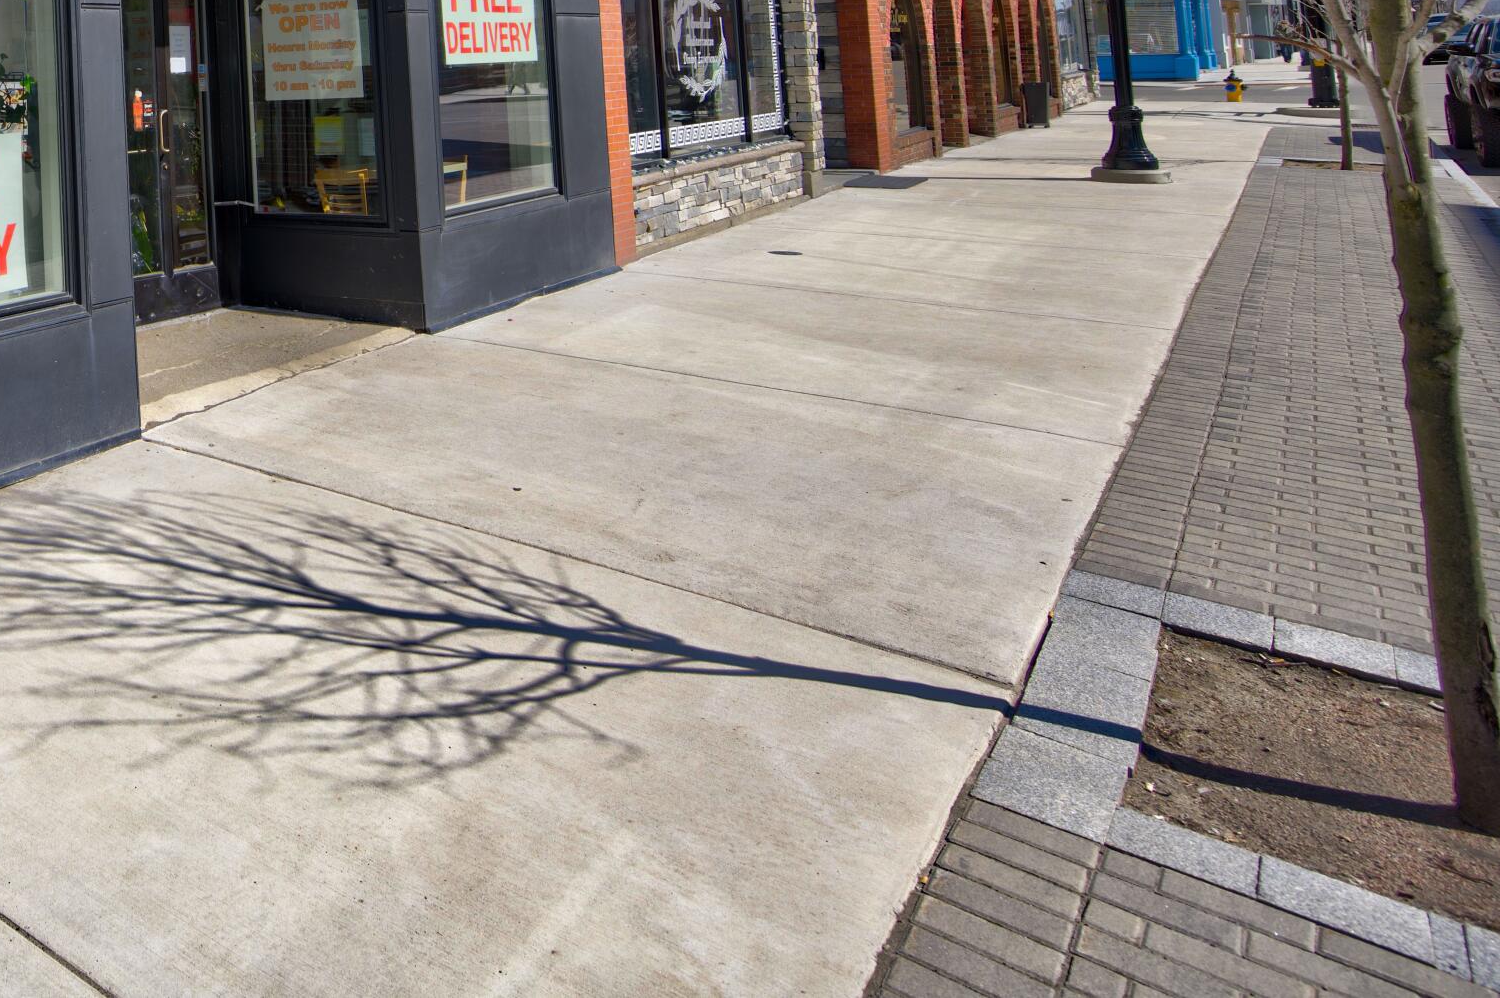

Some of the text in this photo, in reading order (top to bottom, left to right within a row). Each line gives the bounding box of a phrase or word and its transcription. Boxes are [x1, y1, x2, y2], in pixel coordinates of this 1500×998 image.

[268, 0, 348, 14] We are now
[278, 12, 341, 33] OPEN
[308, 38, 356, 51] Monday
[445, 21, 532, 55] DELIVERY
[275, 81, 288, 91] 10
[318, 78, 334, 90] 10
[336, 80, 357, 91] pm
